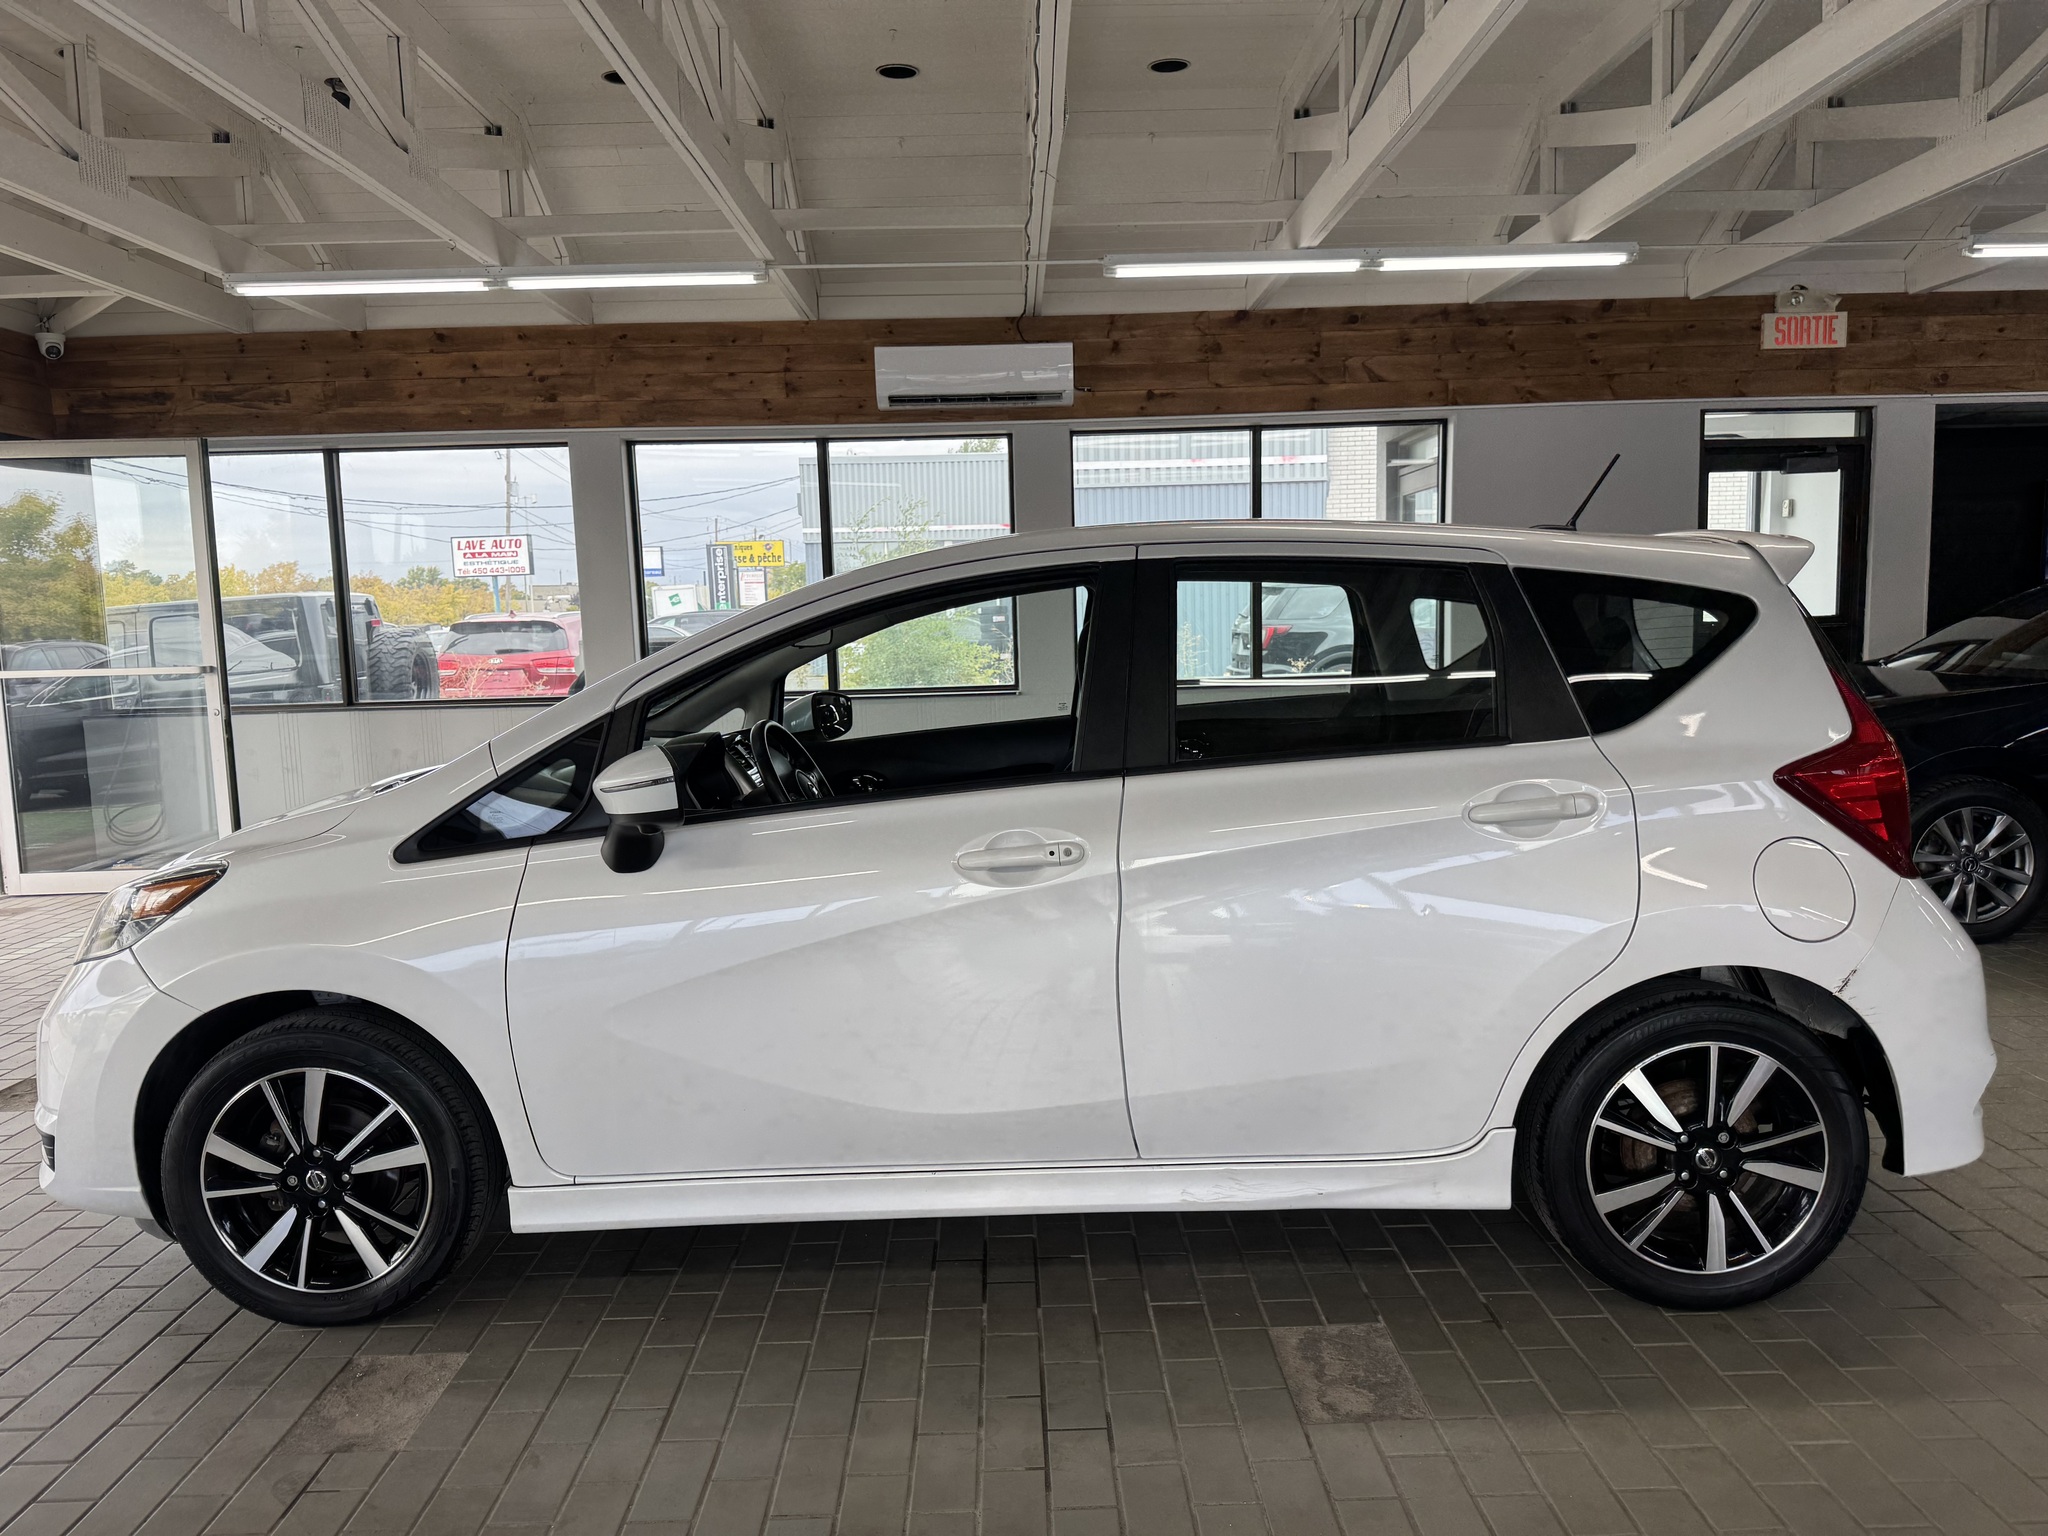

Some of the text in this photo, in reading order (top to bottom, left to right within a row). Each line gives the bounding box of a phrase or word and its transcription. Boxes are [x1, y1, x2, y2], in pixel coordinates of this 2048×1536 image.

[1775, 316, 1838, 345] SORTIE
[457, 539, 522, 551] LAVE AUTO
[748, 554, 756, 563] &
[757, 553, 782, 566] pêche
[489, 566, 526, 574] 443-1009
